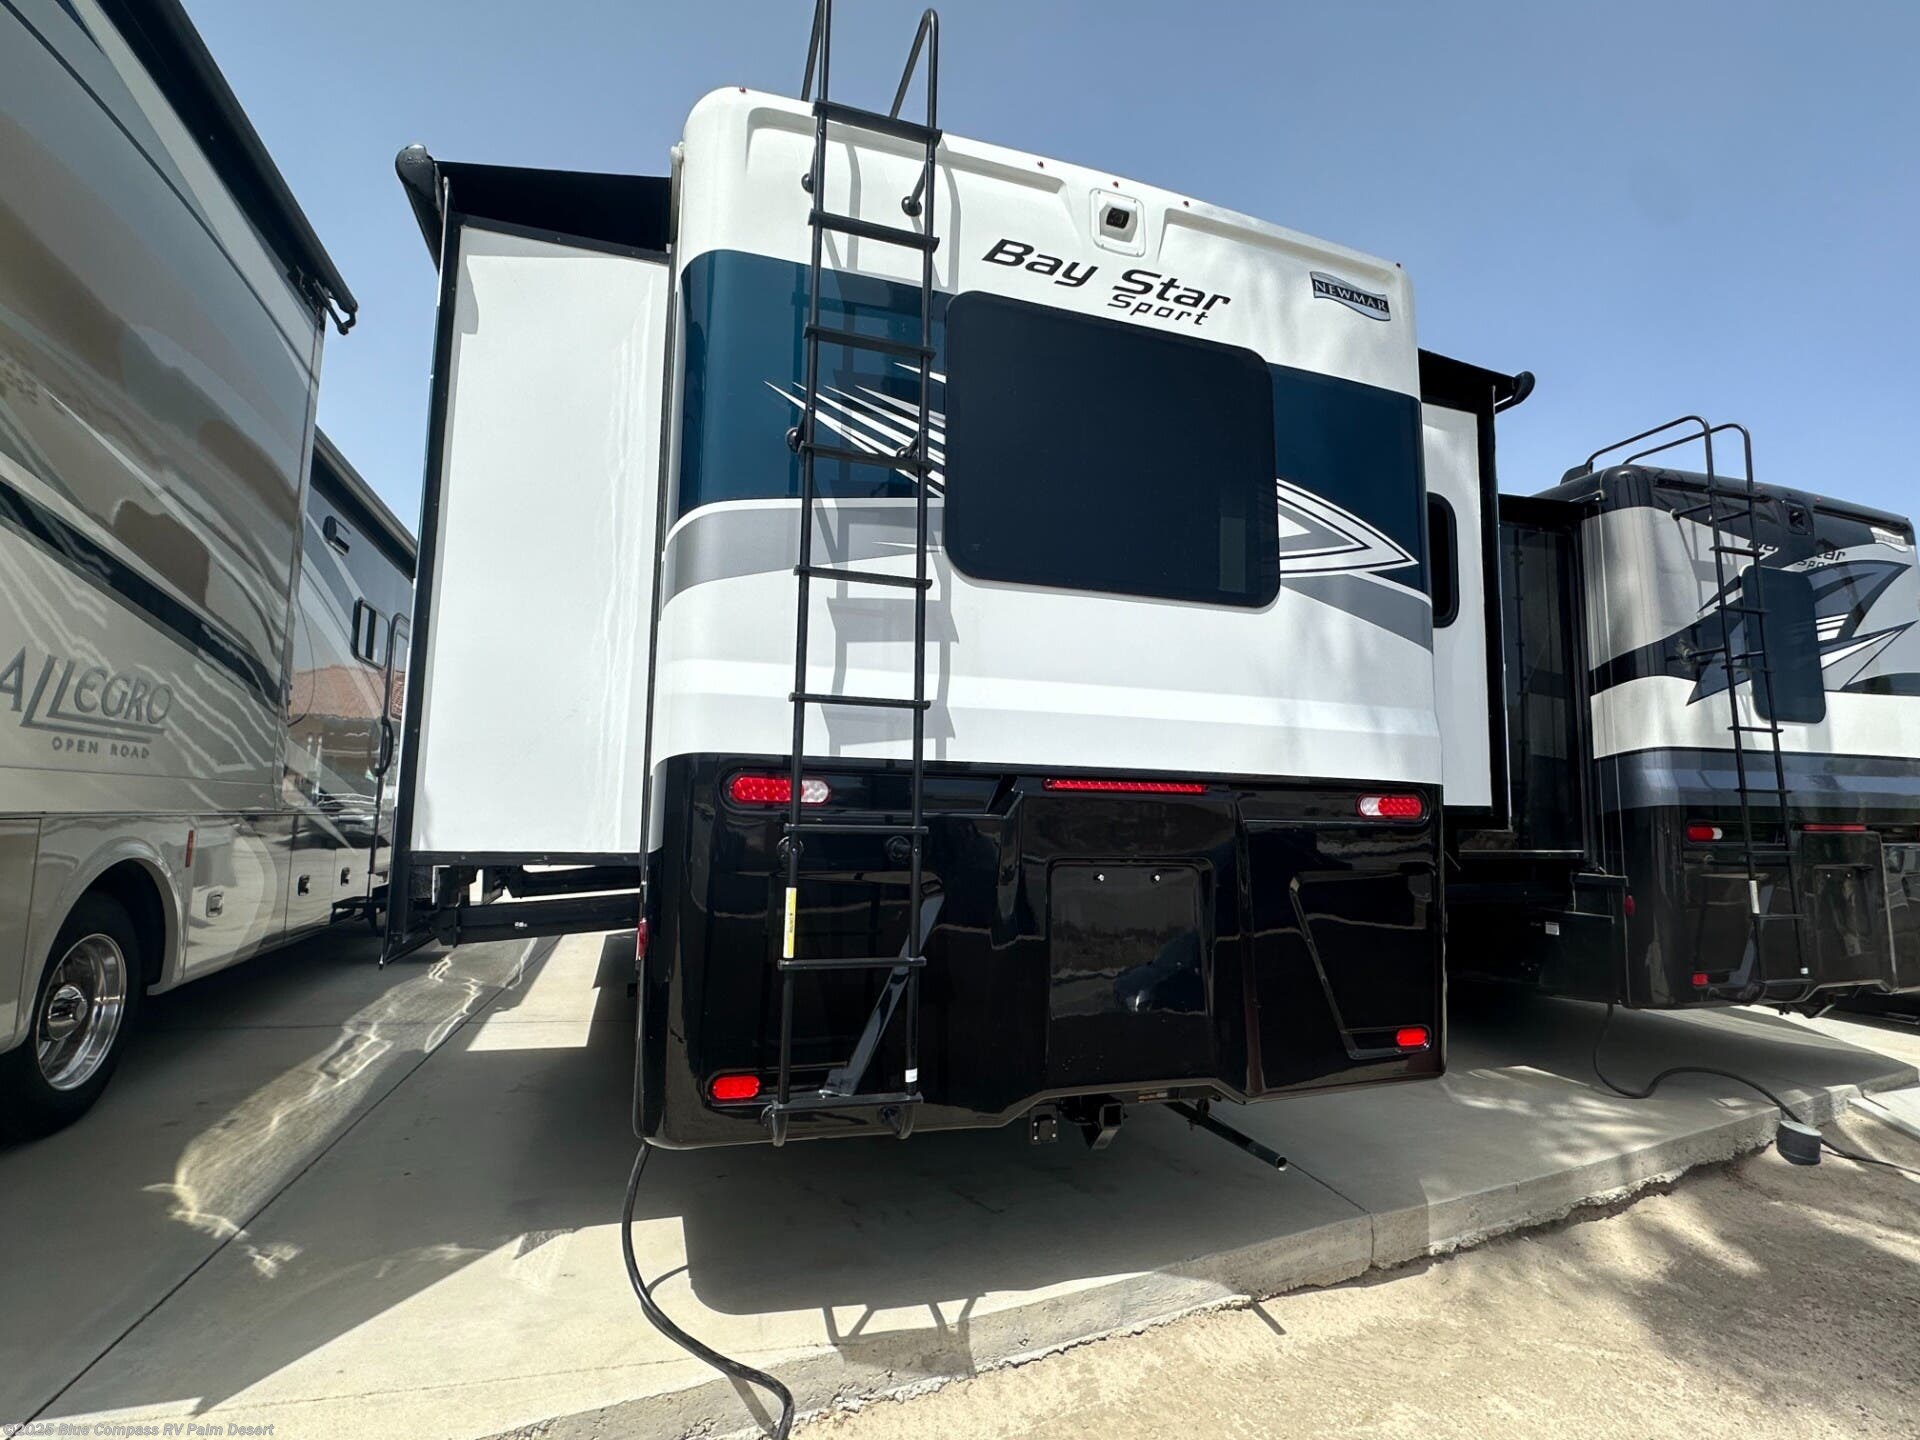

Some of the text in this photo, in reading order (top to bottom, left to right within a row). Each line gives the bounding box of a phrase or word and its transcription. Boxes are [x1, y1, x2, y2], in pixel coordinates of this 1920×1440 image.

[982, 238, 1231, 311] Bay Star
[1107, 293, 1209, 325] Sport
[1314, 280, 1388, 311] NEWMAR
[0, 646, 173, 740] ALLEGRO
[51, 736, 150, 759] OPEN ROAD
